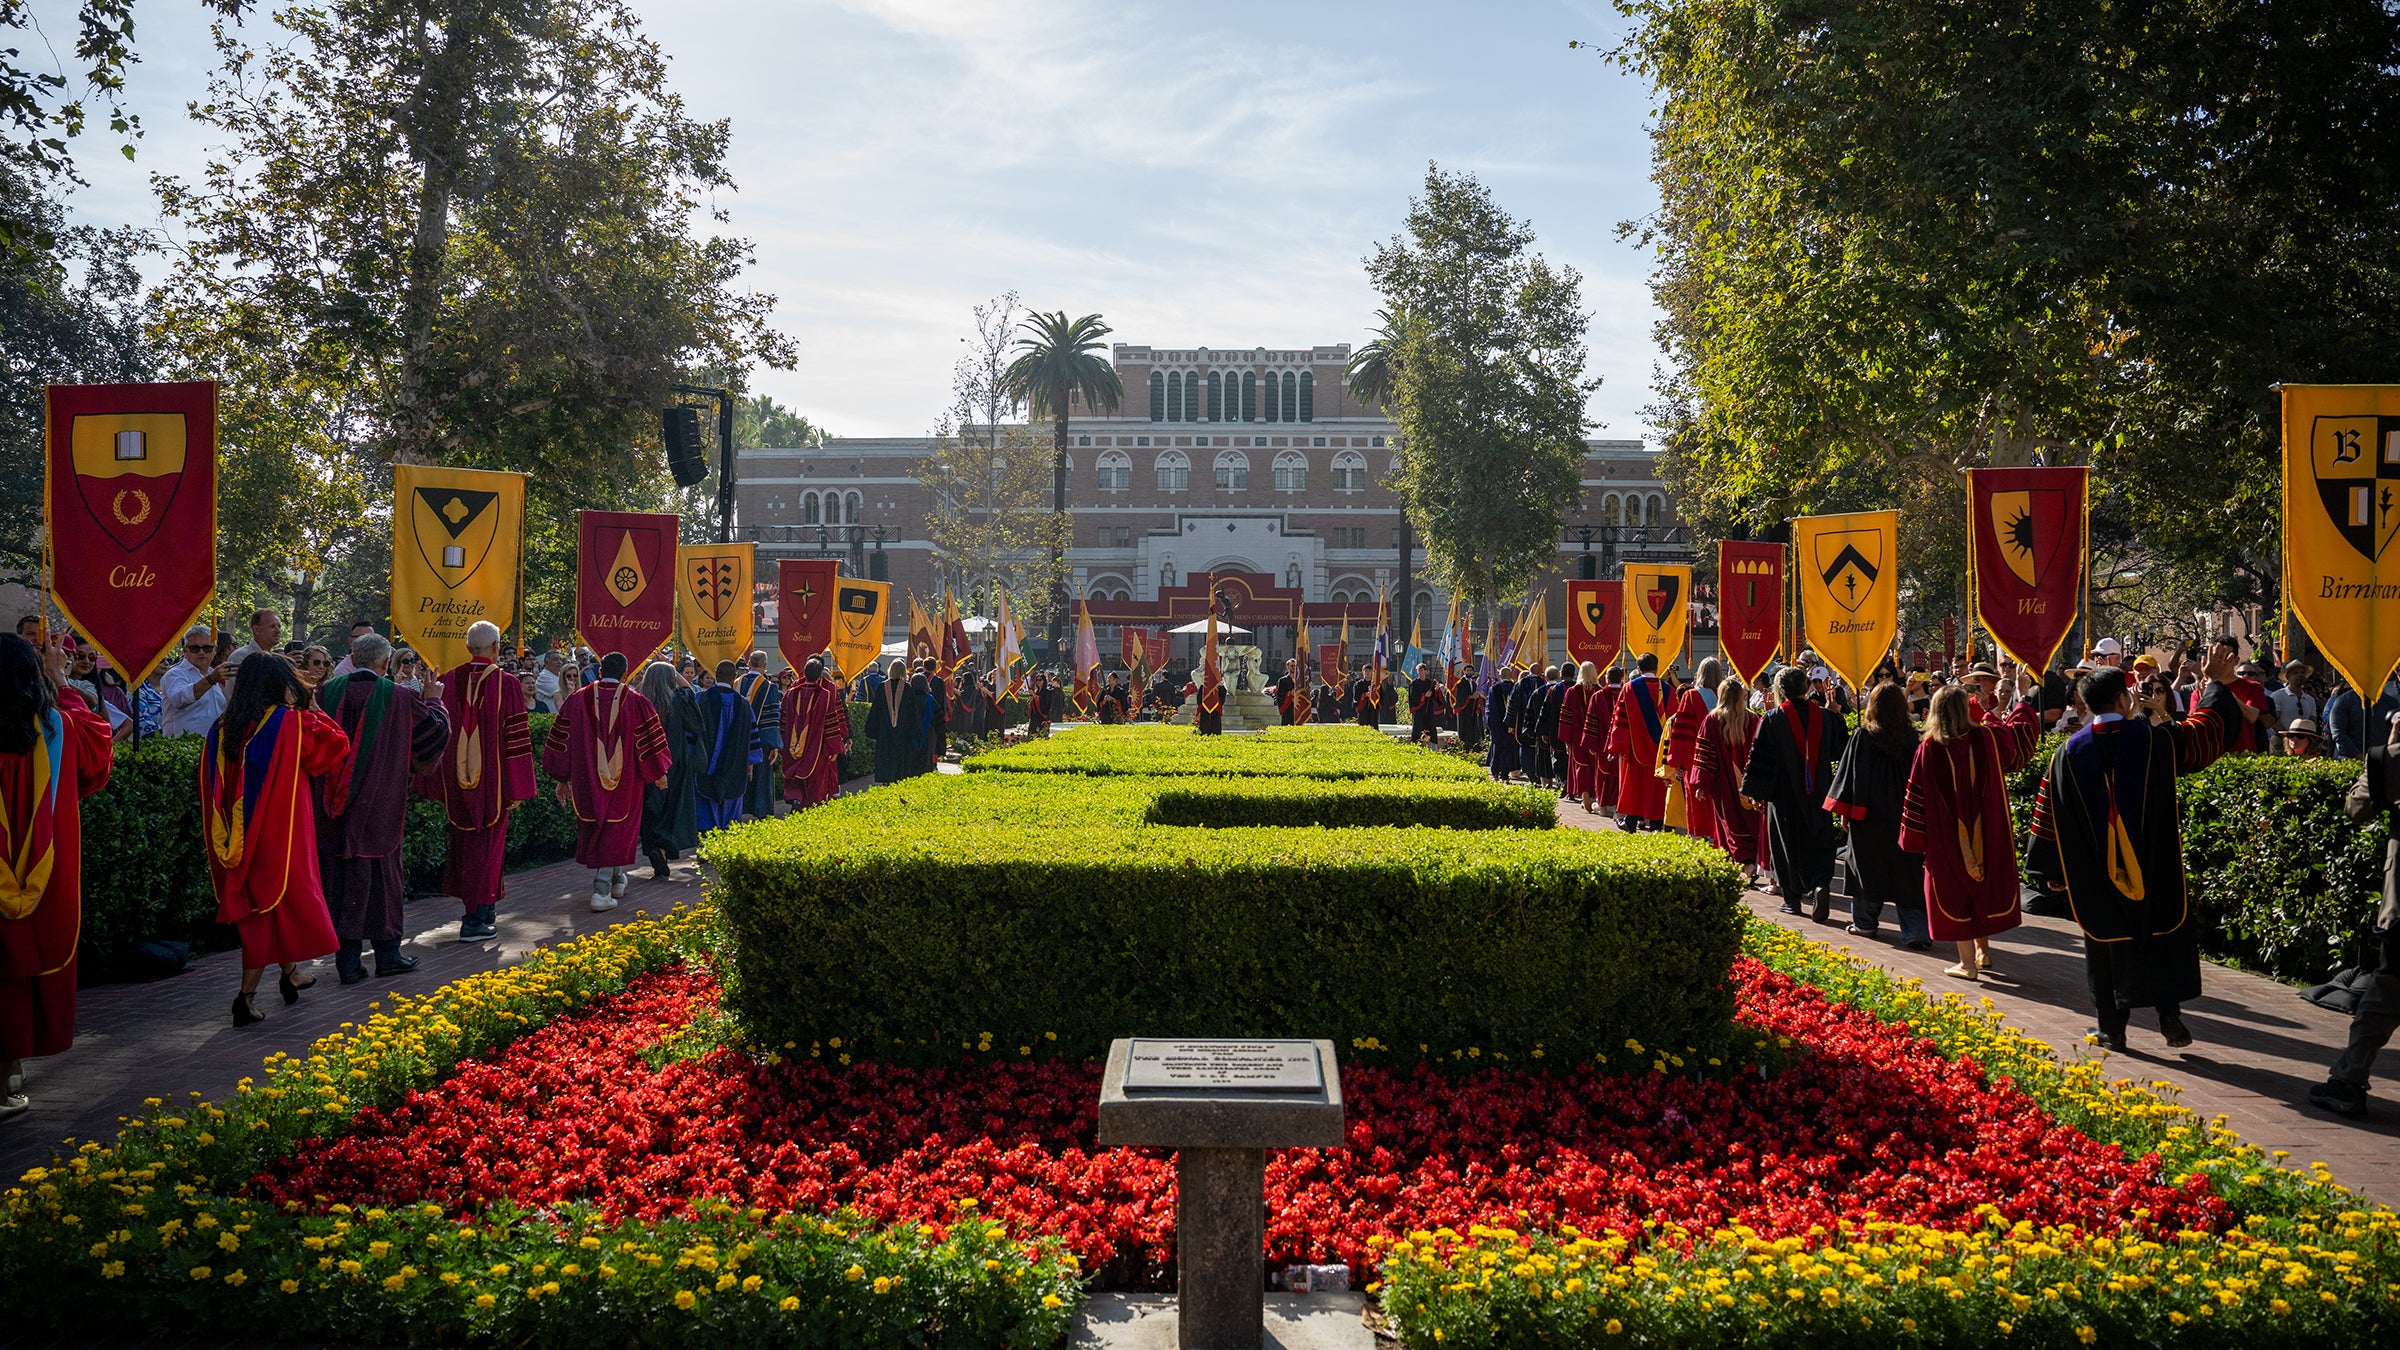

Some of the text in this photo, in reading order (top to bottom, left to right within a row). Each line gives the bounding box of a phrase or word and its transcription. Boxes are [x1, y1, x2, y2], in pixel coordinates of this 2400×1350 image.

[109, 564, 156, 588] Cale
[2319, 575, 2400, 599] Birnkran
[418, 596, 485, 616] Parkside
[2017, 597, 2047, 616] West
[434, 615, 468, 627] Arts &
[588, 613, 661, 630] McMorrow
[1828, 619, 1876, 635] Bohnett
[421, 627, 468, 640] Humanit
[697, 626, 737, 639] Parkside
[697, 638, 737, 647] International
[1578, 641, 1613, 654] Cowlings
